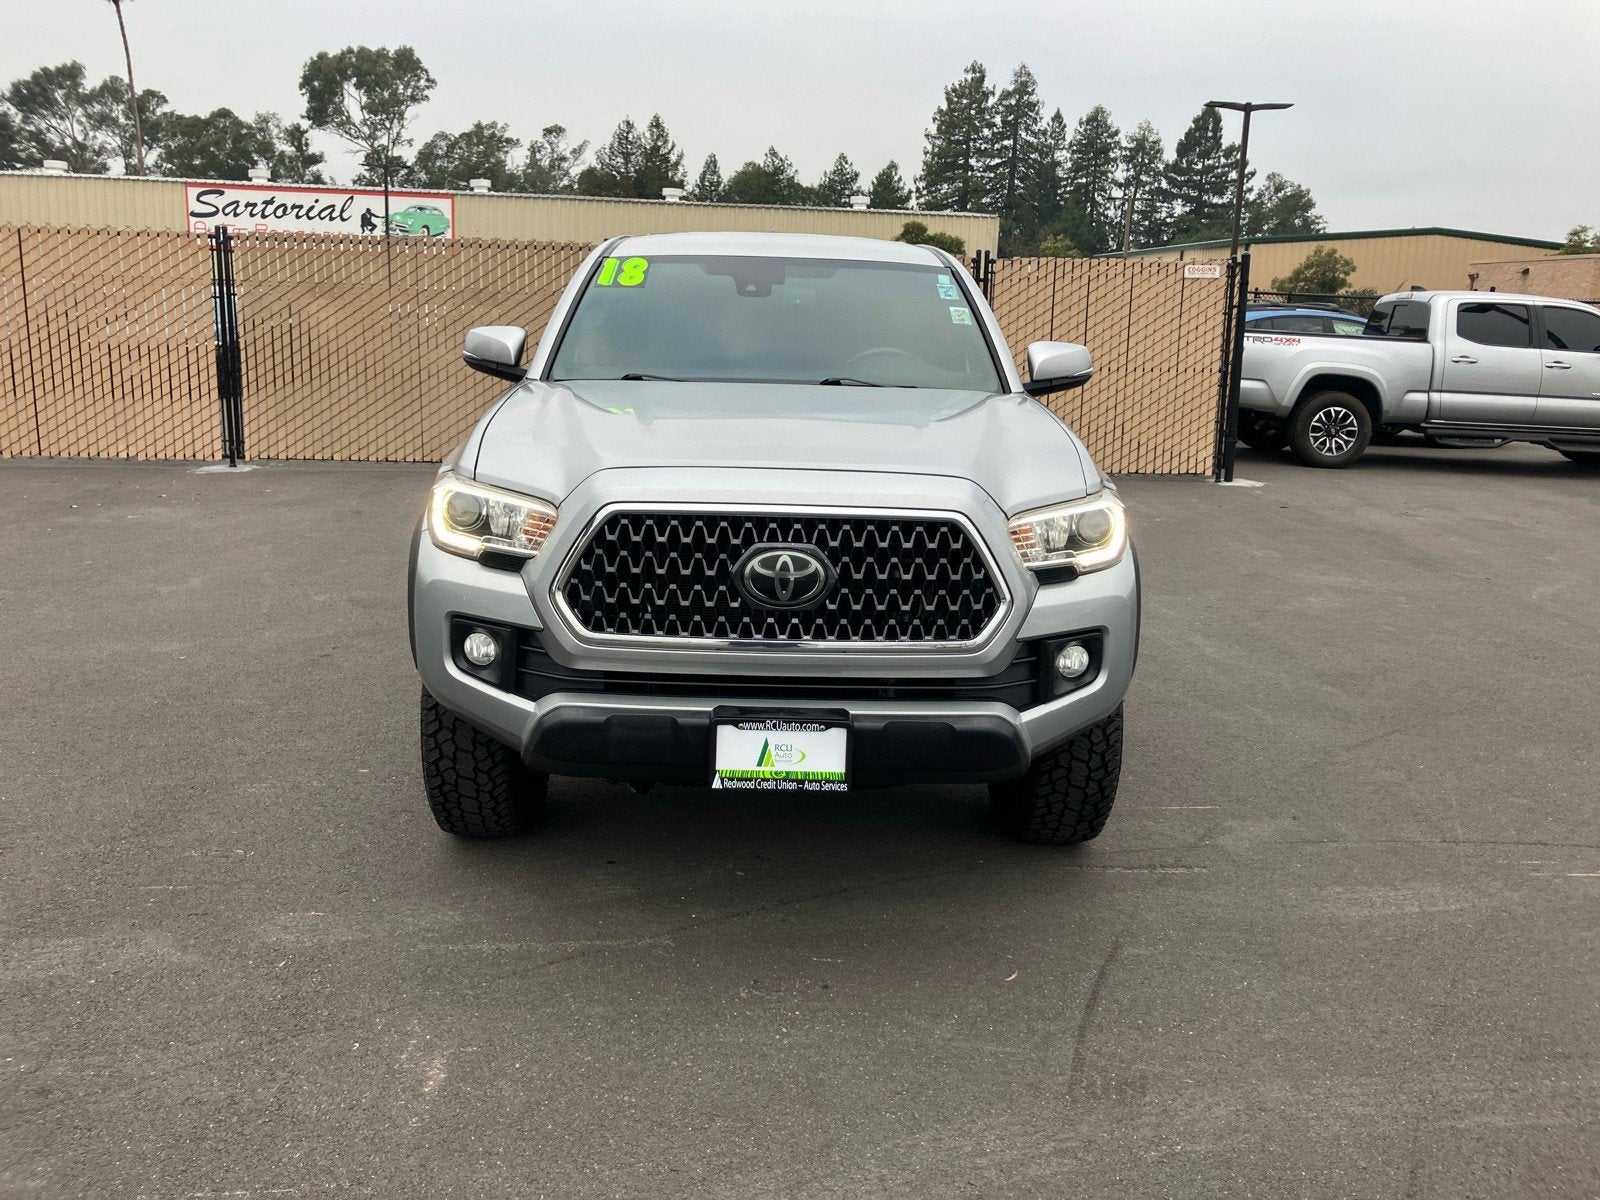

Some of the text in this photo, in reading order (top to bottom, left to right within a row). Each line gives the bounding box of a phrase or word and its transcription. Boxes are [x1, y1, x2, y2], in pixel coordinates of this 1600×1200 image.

[189, 189, 355, 223] Sartorial
[596, 256, 649, 287] 18
[743, 720, 820, 732] www.RCUauto.com
[774, 743, 793, 752] RCU
[723, 778, 755, 789] Redwood
[756, 779, 777, 789] Credit
[777, 779, 798, 790] Union
[803, 780, 821, 790] Auto
[821, 781, 848, 792] Services
